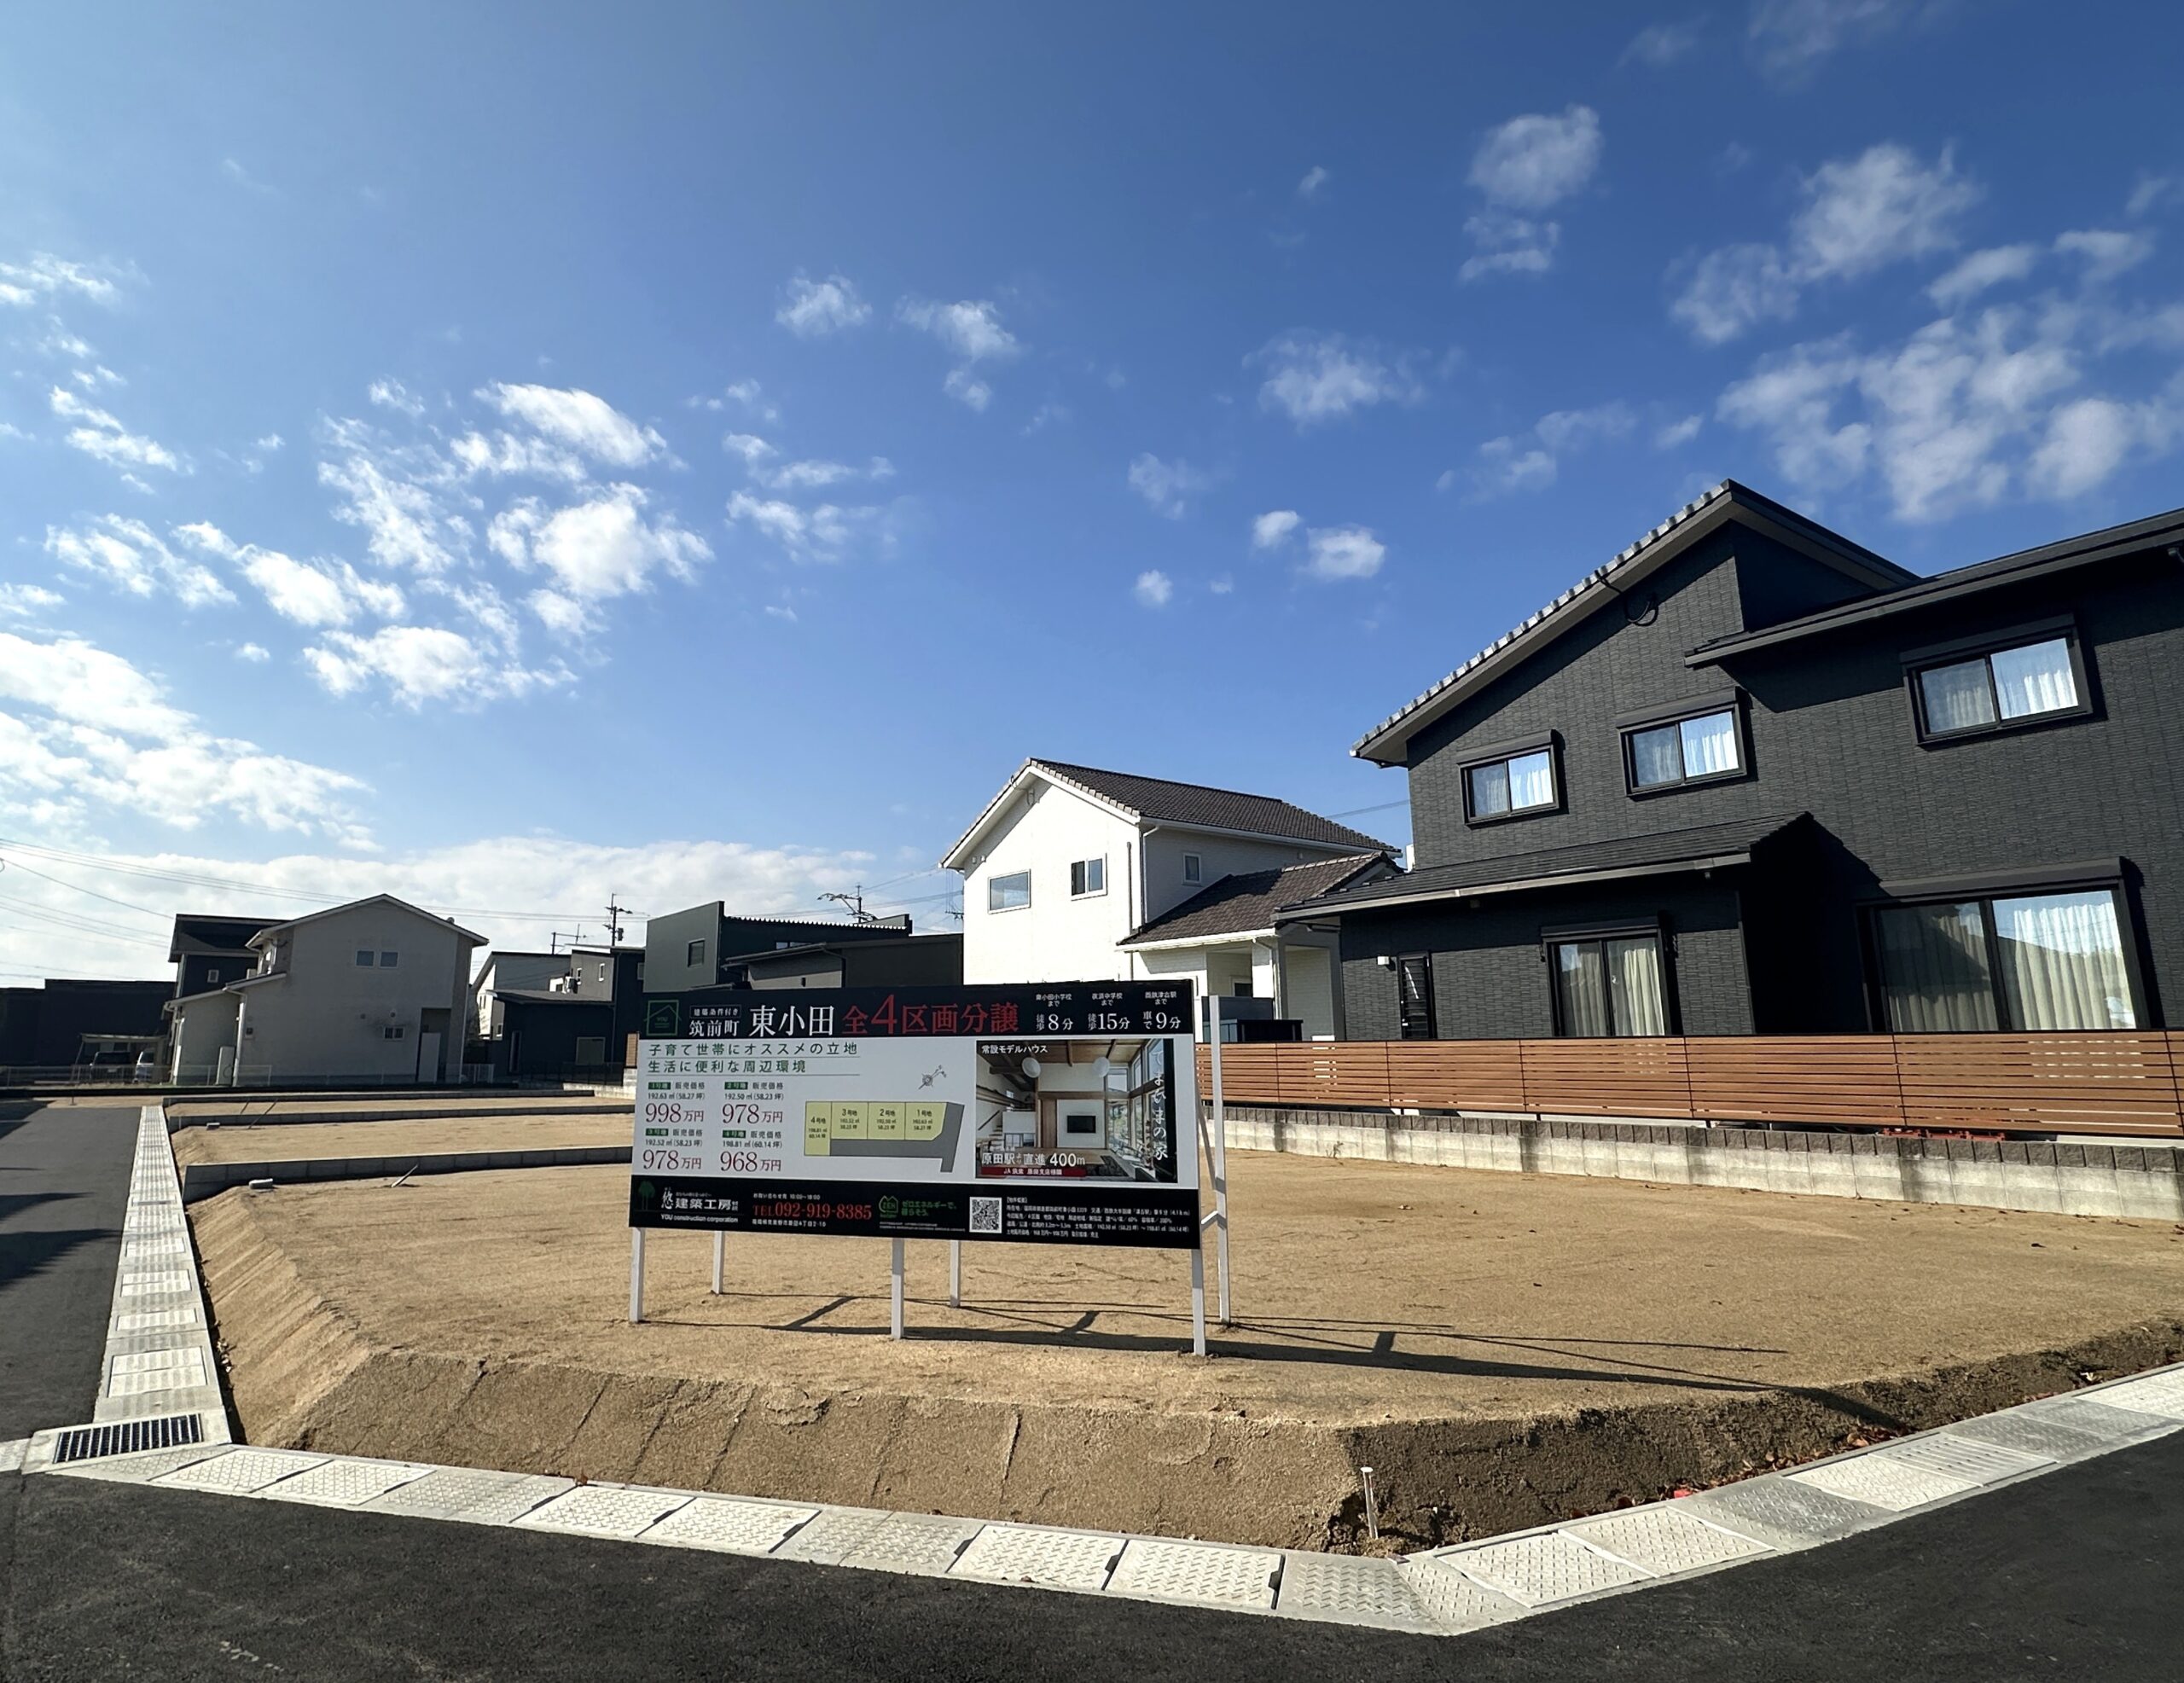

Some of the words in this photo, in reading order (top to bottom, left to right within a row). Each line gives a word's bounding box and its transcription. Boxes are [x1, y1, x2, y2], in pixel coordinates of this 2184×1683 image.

[749, 1005, 834, 1037] 東小田
[842, 994, 1019, 1035] 全4区画分譲
[688, 1019, 740, 1037] 筑前町
[648, 1042, 857, 1057] 子育て世帯にオススメの立地
[981, 1045, 1048, 1054] 常設モデルハウス
[648, 1059, 806, 1073] 生活に便利な周辺環境
[645, 1102, 705, 1123] 998万円
[722, 1103, 783, 1124] 978万円
[642, 1149, 702, 1170] 978万円
[720, 1152, 781, 1172] 968万円
